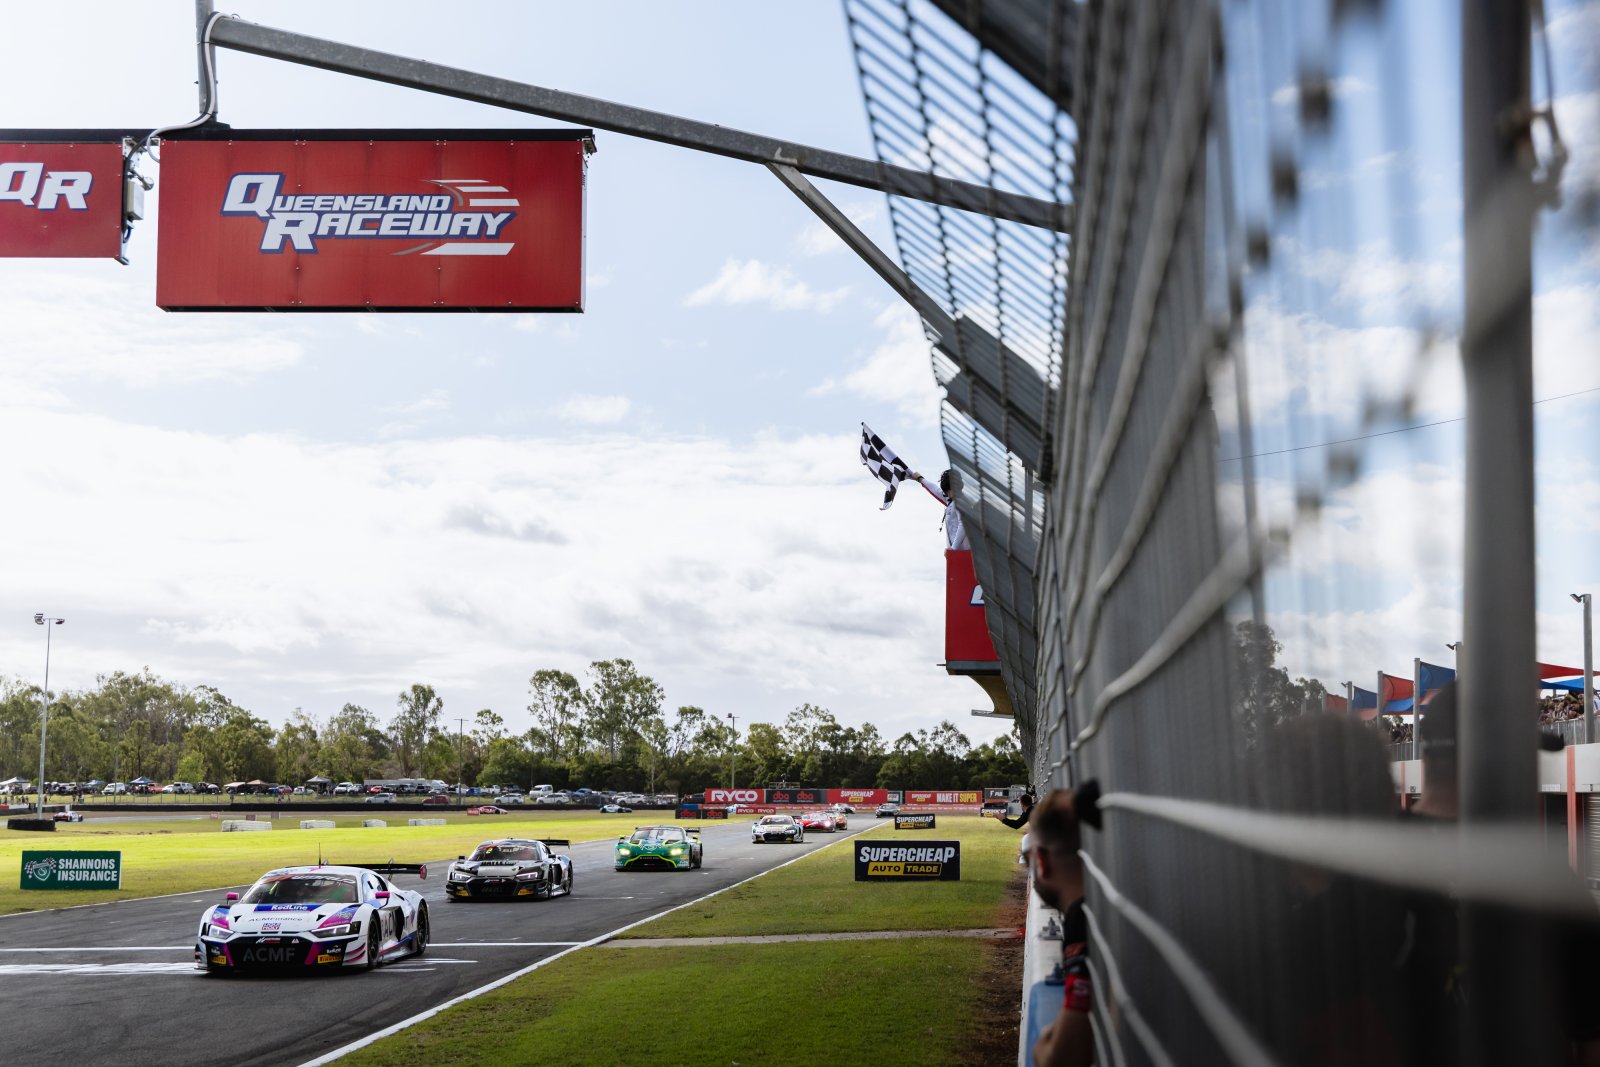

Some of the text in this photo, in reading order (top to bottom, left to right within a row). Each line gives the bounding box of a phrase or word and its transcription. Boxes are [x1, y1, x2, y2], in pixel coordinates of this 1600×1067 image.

[0, 162, 92, 210] QR
[221, 172, 453, 219] QUEENSLAND
[259, 211, 515, 253] RACEWAY
[711, 790, 758, 802] RYCO
[772, 791, 790, 800] dba
[796, 791, 814, 800] dba
[840, 790, 874, 798] SUPERCHEAP
[936, 793, 977, 803] MAKE IT SUPER
[896, 816, 934, 824] SUPERCHEAP
[859, 846, 955, 863] SUPERCHEAP
[58, 858, 116, 870] SHANNONS
[906, 865, 938, 873] TRADE
[57, 870, 118, 881] INSURANCE
[243, 947, 296, 962] ACMF
